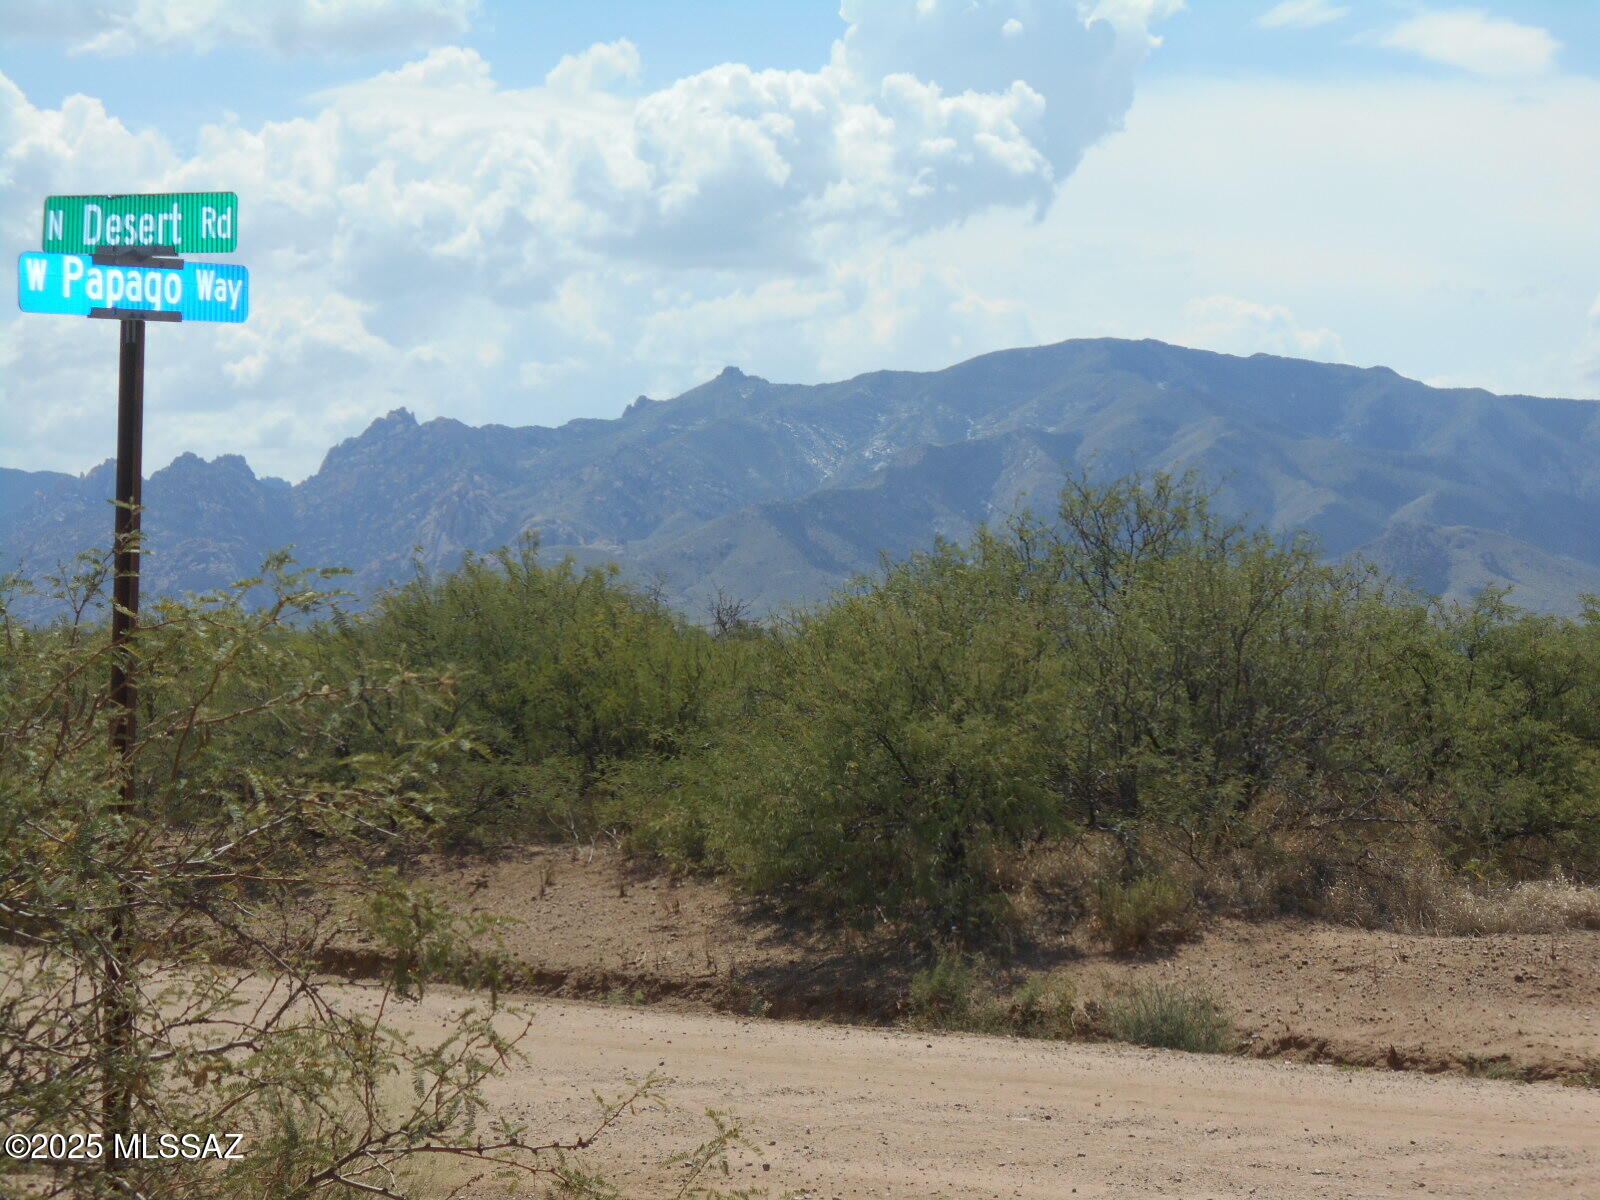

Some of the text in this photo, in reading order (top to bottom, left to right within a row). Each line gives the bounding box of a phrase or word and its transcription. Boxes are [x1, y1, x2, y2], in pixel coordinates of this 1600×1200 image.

[48, 202, 232, 246] N Desert Rd
[26, 258, 47, 291] W
[196, 269, 243, 310] Way
